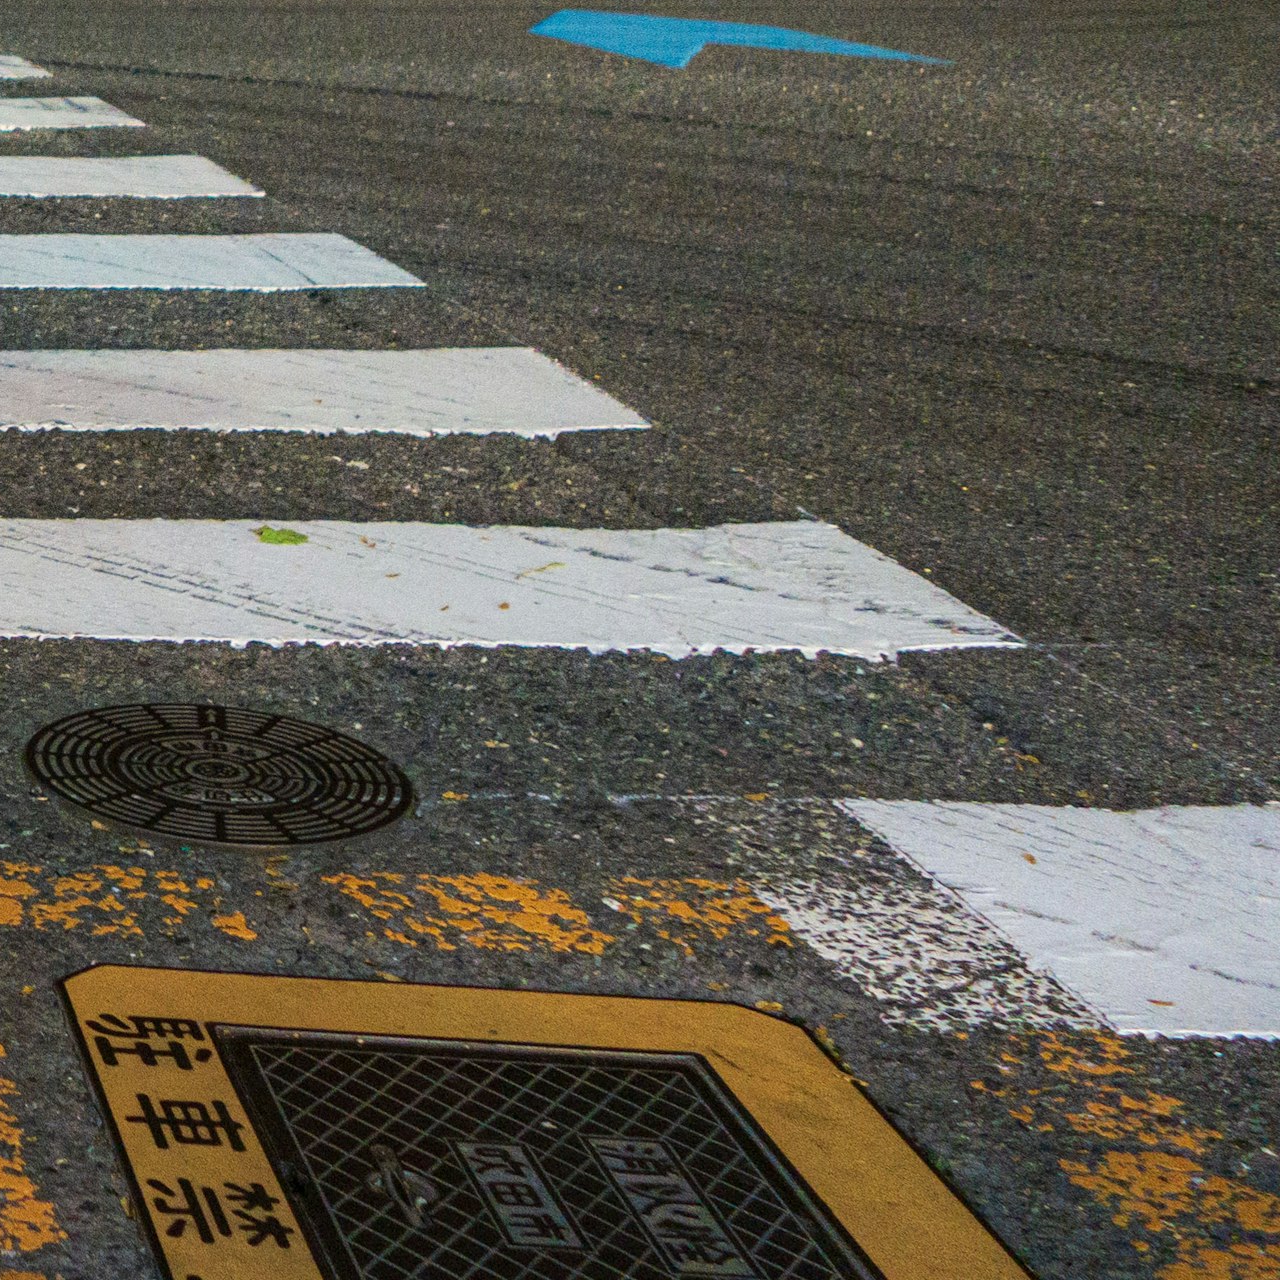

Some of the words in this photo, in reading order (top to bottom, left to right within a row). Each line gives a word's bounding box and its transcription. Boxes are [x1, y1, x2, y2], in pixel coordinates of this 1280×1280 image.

[86, 1012, 294, 1280] 駐車禁
[469, 1147, 575, 1244] 吹田市
[590, 1141, 744, 1271] 消火栓
